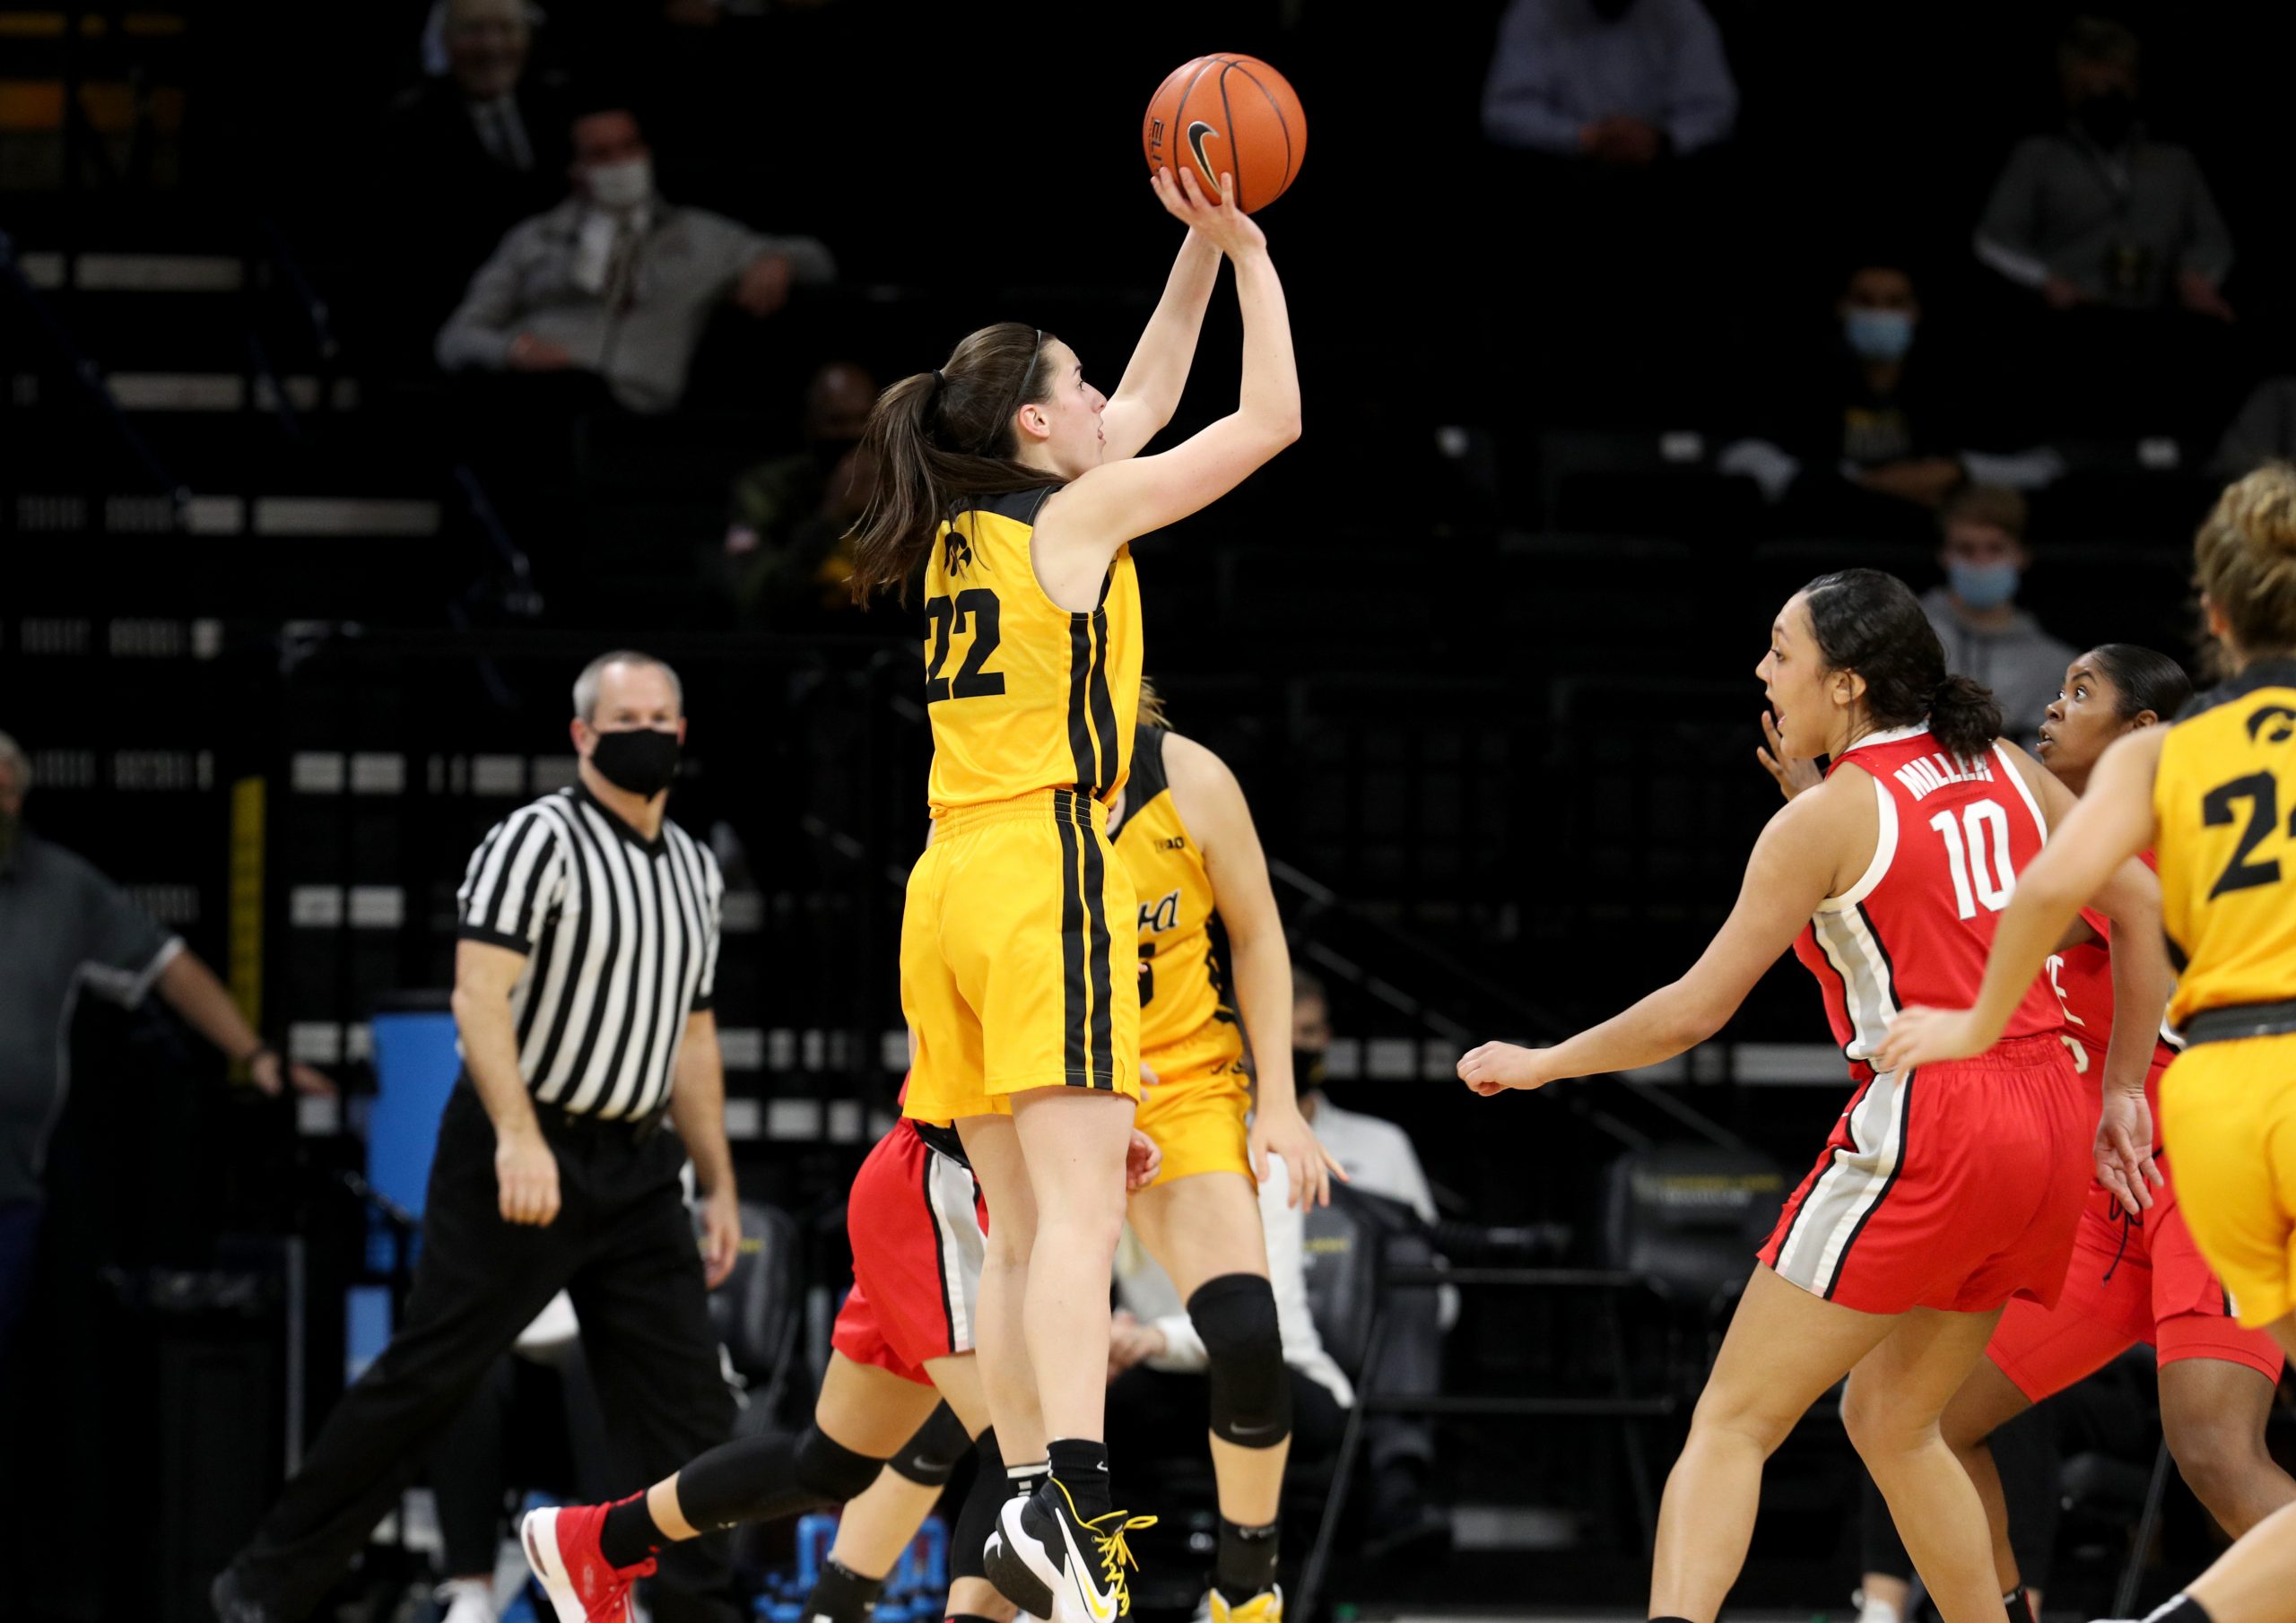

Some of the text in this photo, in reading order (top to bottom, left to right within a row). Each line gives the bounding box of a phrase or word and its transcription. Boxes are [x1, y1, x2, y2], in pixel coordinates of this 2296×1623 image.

[925, 587, 1005, 703] 22
[1892, 751, 1995, 802] MILLER
[2201, 769, 2296, 903] 2
[1928, 797, 2017, 921] 10
